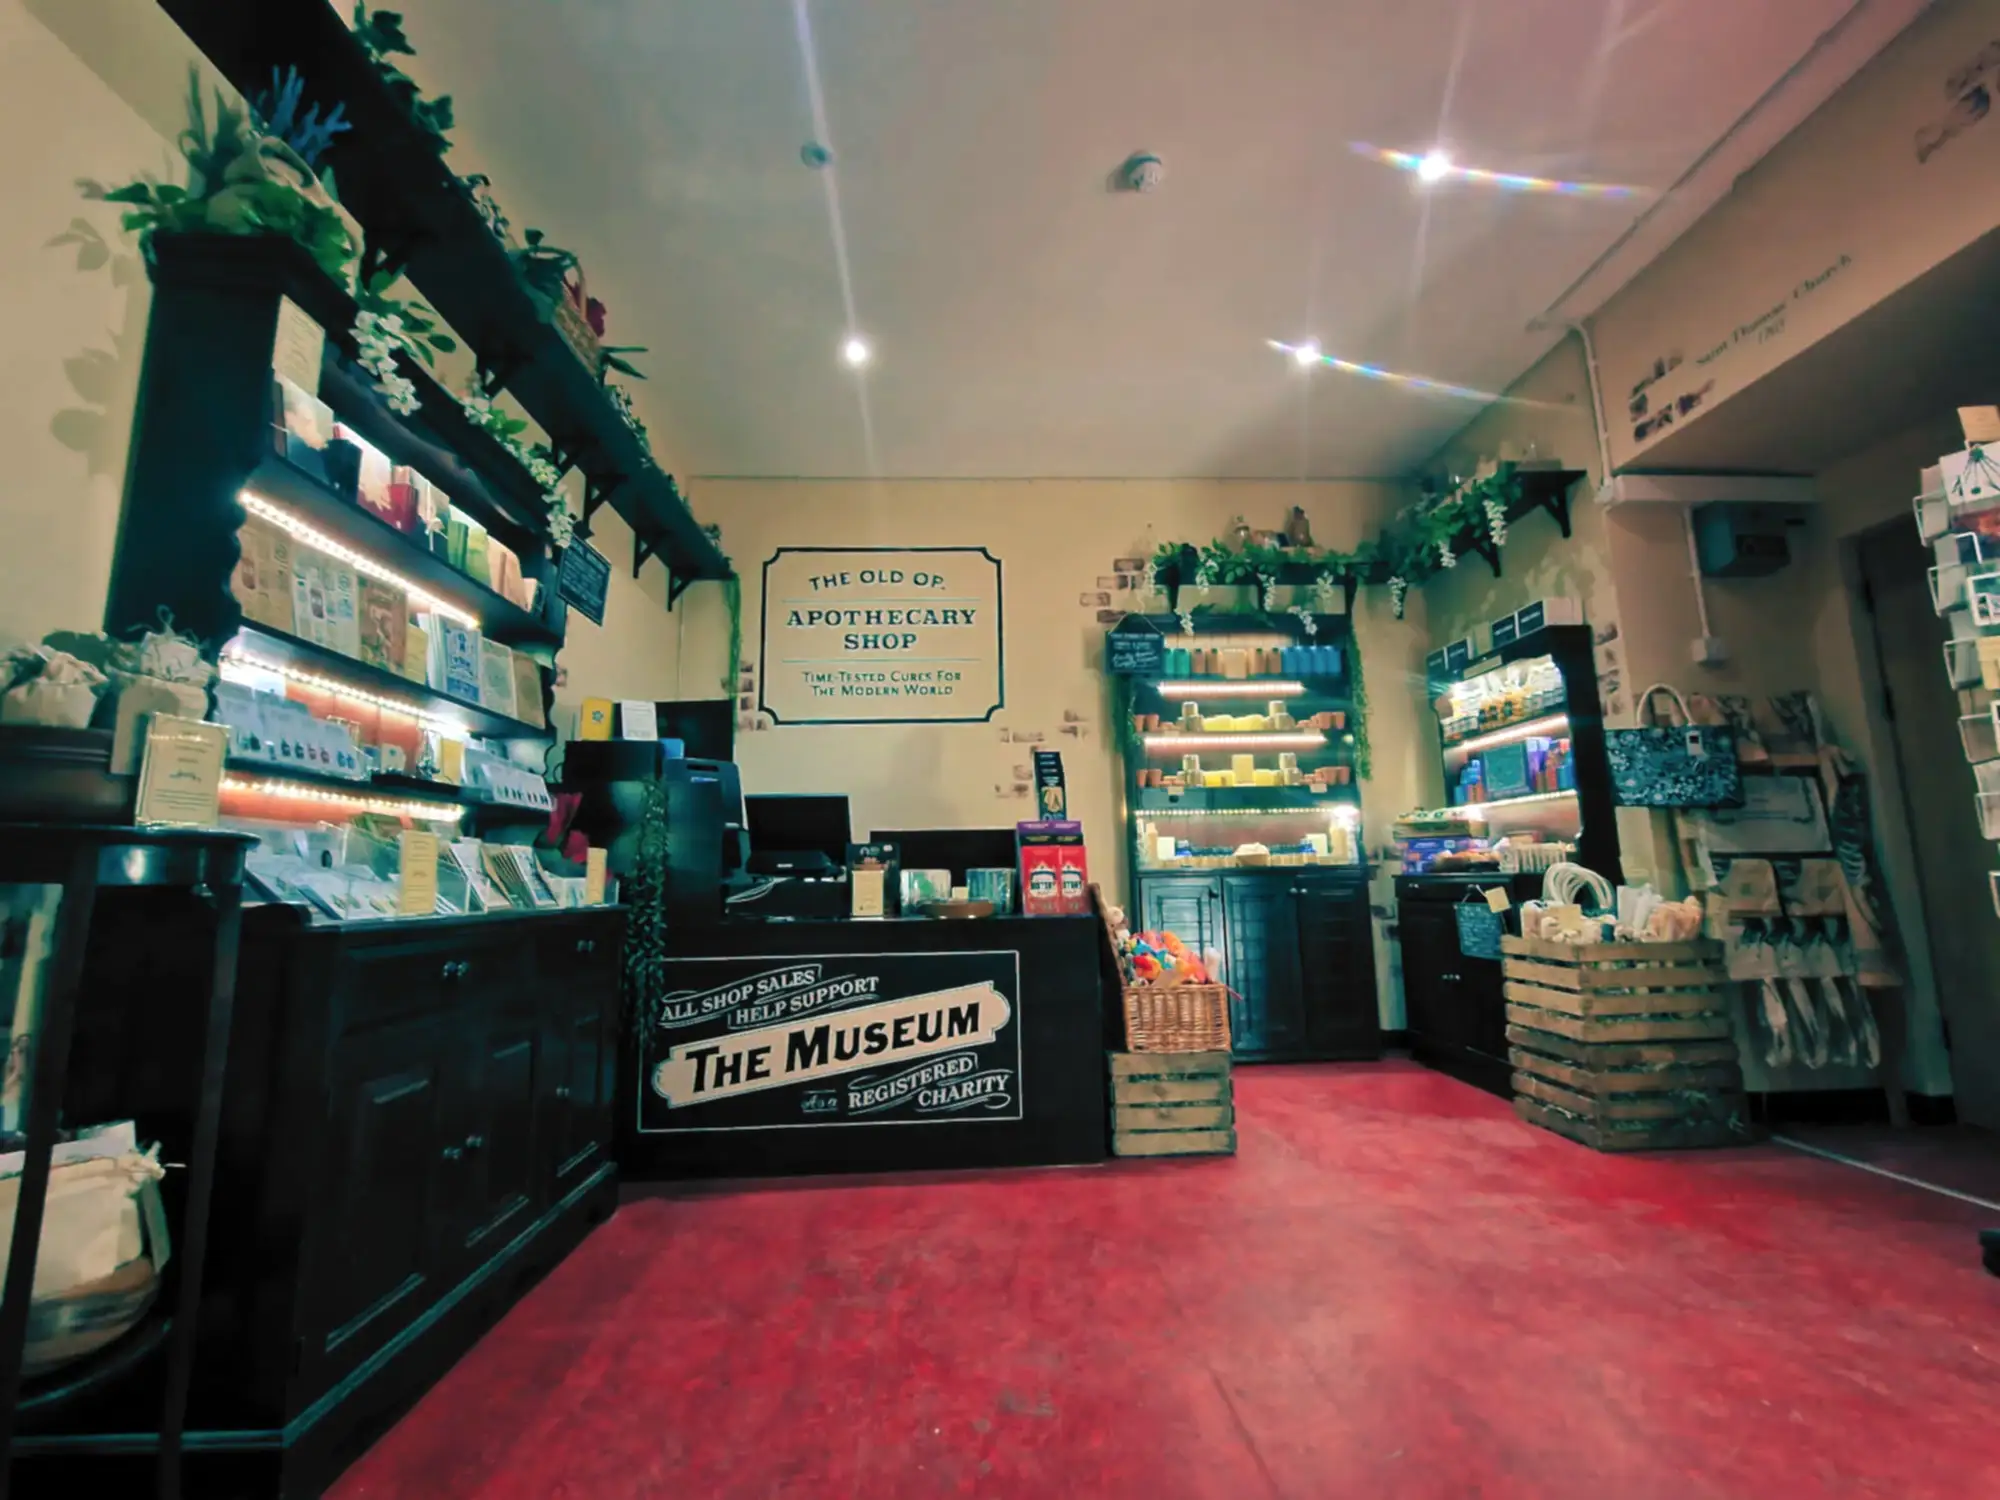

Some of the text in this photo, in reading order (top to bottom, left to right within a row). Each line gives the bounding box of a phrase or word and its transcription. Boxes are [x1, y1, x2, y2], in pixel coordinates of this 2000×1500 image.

[809, 570, 946, 591] THE OLD OP.
[786, 608, 977, 626] APOTHECARY
[843, 633, 917, 650] SHOP
[812, 685, 835, 696] THE
[904, 684, 954, 695] WORLD
[659, 969, 816, 1023] ALL SHOP SALES
[735, 976, 880, 1026] HELP SUPPORT
[684, 1002, 981, 1093] THE MUSEUM
[847, 1056, 974, 1110] REGISTERED
[917, 1075, 1010, 1107] CHARITY
